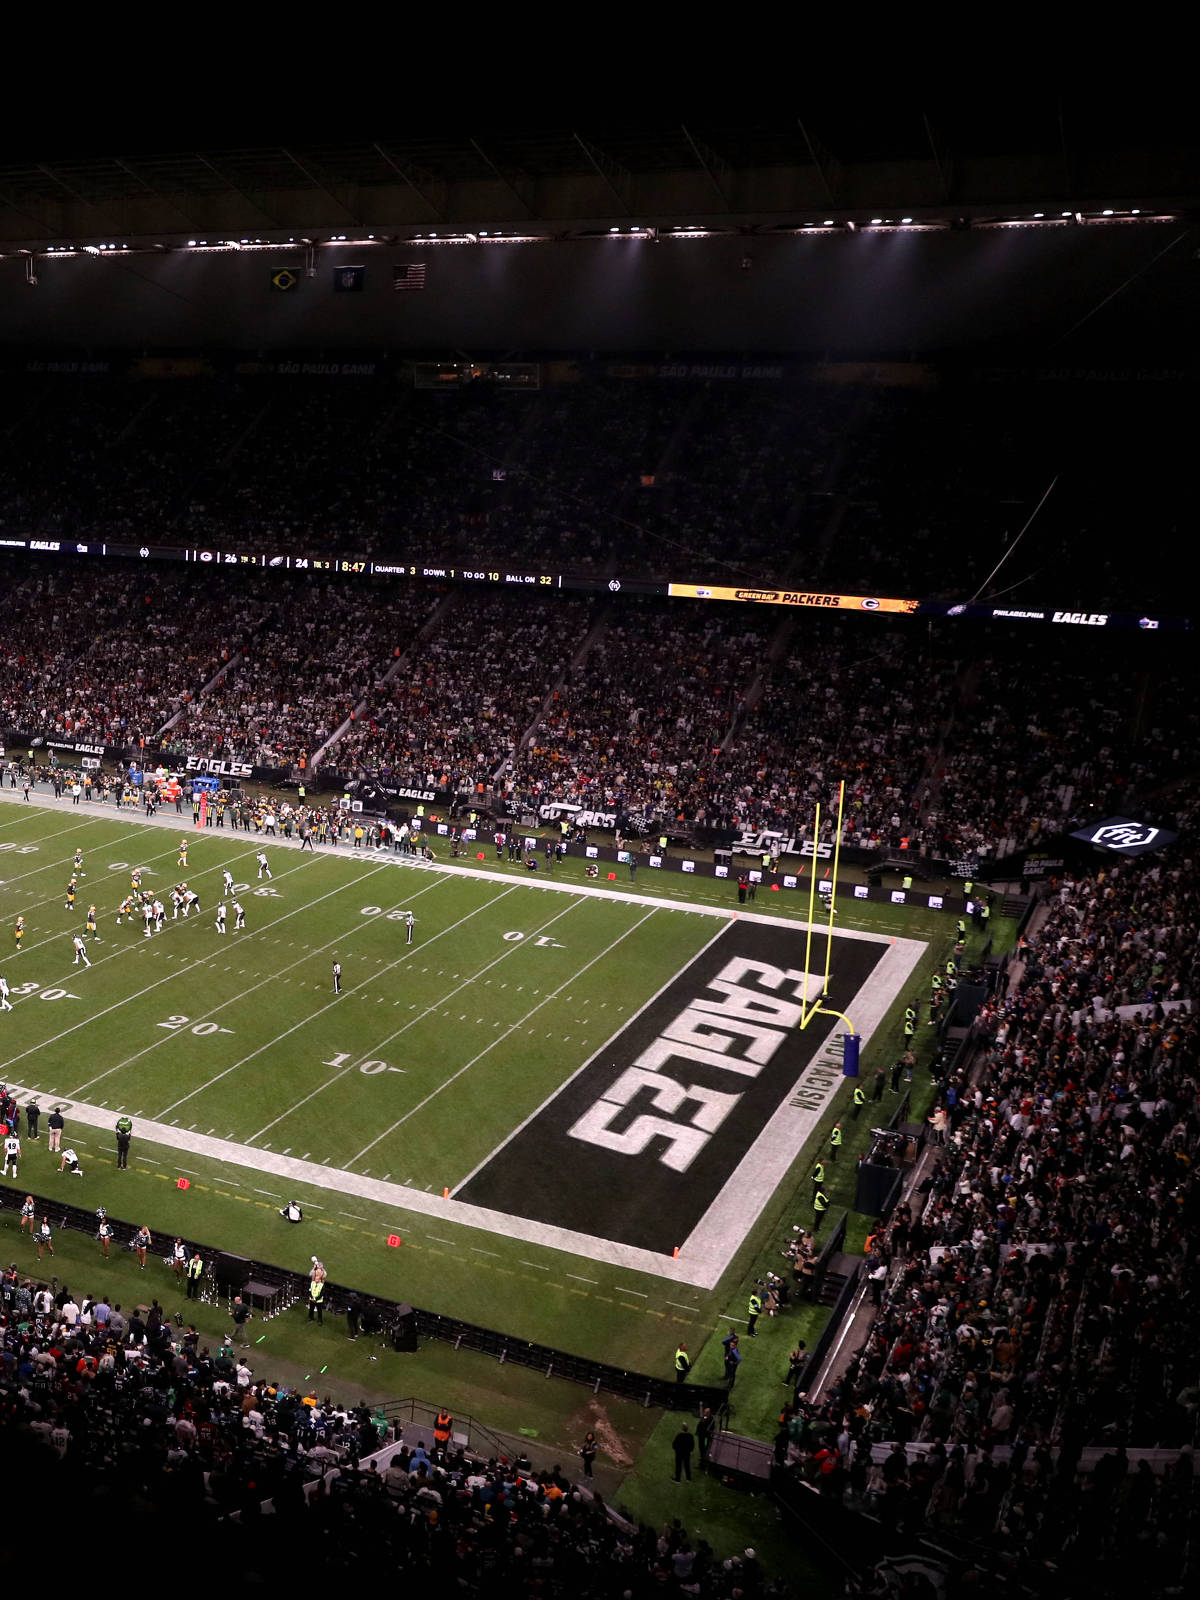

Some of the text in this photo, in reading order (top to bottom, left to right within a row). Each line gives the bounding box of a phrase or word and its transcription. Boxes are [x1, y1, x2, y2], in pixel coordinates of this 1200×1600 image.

[30, 540, 61, 551] EAGLES
[225, 554, 237, 563] 26
[295, 558, 309, 568] 24
[341, 560, 366, 573] 8:47
[375, 566, 405, 574] QUARTER
[410, 566, 416, 575] 3
[423, 568, 445, 577] DOWN
[463, 571, 473, 579] TO
[474, 572, 485, 580] GO
[488, 572, 499, 581] 10
[505, 574, 523, 583] BALL
[524, 575, 536, 584] ON
[540, 576, 552, 585] 32
[782, 593, 840, 607] PACKERS
[992, 609, 1108, 626] PHILADELPHIA EAGLES
[46, 741, 105, 755] PHILADELPHIA EAGLES
[184, 756, 253, 778] EAGLES
[399, 788, 435, 801] EAGLES
[540, 804, 561, 820] GO
[503, 931, 548, 946] 10
[10, 981, 68, 1001] 30
[156, 1014, 219, 1036] 20
[323, 1051, 390, 1076] 10
[566, 955, 833, 1173] EAGLES
[789, 1060, 845, 1111] RACISM
